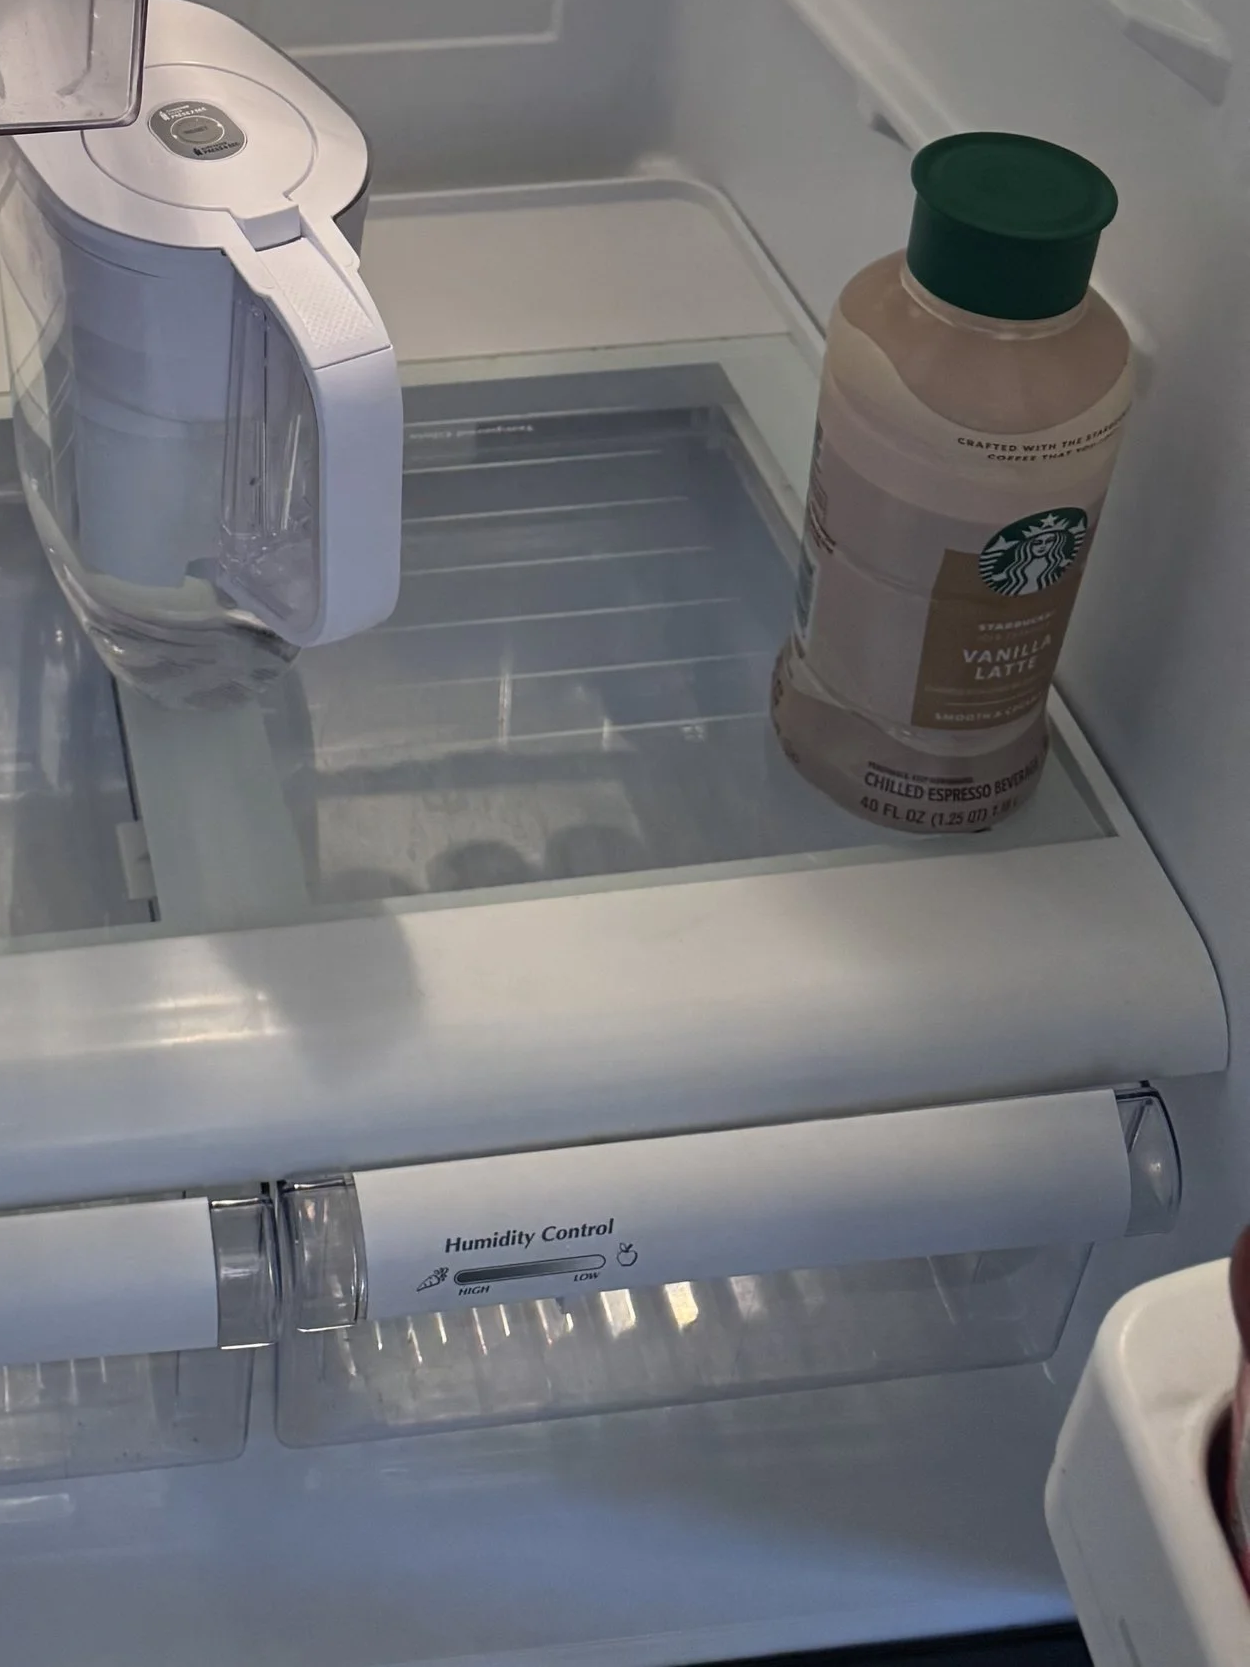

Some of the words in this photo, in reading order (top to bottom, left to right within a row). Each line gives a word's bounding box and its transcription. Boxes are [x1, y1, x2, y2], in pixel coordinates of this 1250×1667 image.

[957, 436, 1018, 453] CRAFTED
[1022, 442, 1058, 453] WITH
[1061, 437, 1083, 450] THE
[987, 452, 1037, 463] COFFEE
[962, 633, 1053, 664] VANILLA
[974, 655, 1039, 681] LATTE
[934, 711, 992, 723] SMOOTH
[863, 771, 924, 801] CHILLED
[928, 783, 992, 803] ESPRESSO
[859, 795, 879, 813] 40
[882, 802, 901, 821] FL
[905, 808, 927, 824] OZ
[930, 811, 964, 828] (1.25
[444, 1229, 536, 1254] Humidity
[541, 1217, 615, 1243] Control
[458, 1284, 491, 1297] HIGH
[573, 1271, 601, 1283] LOW
